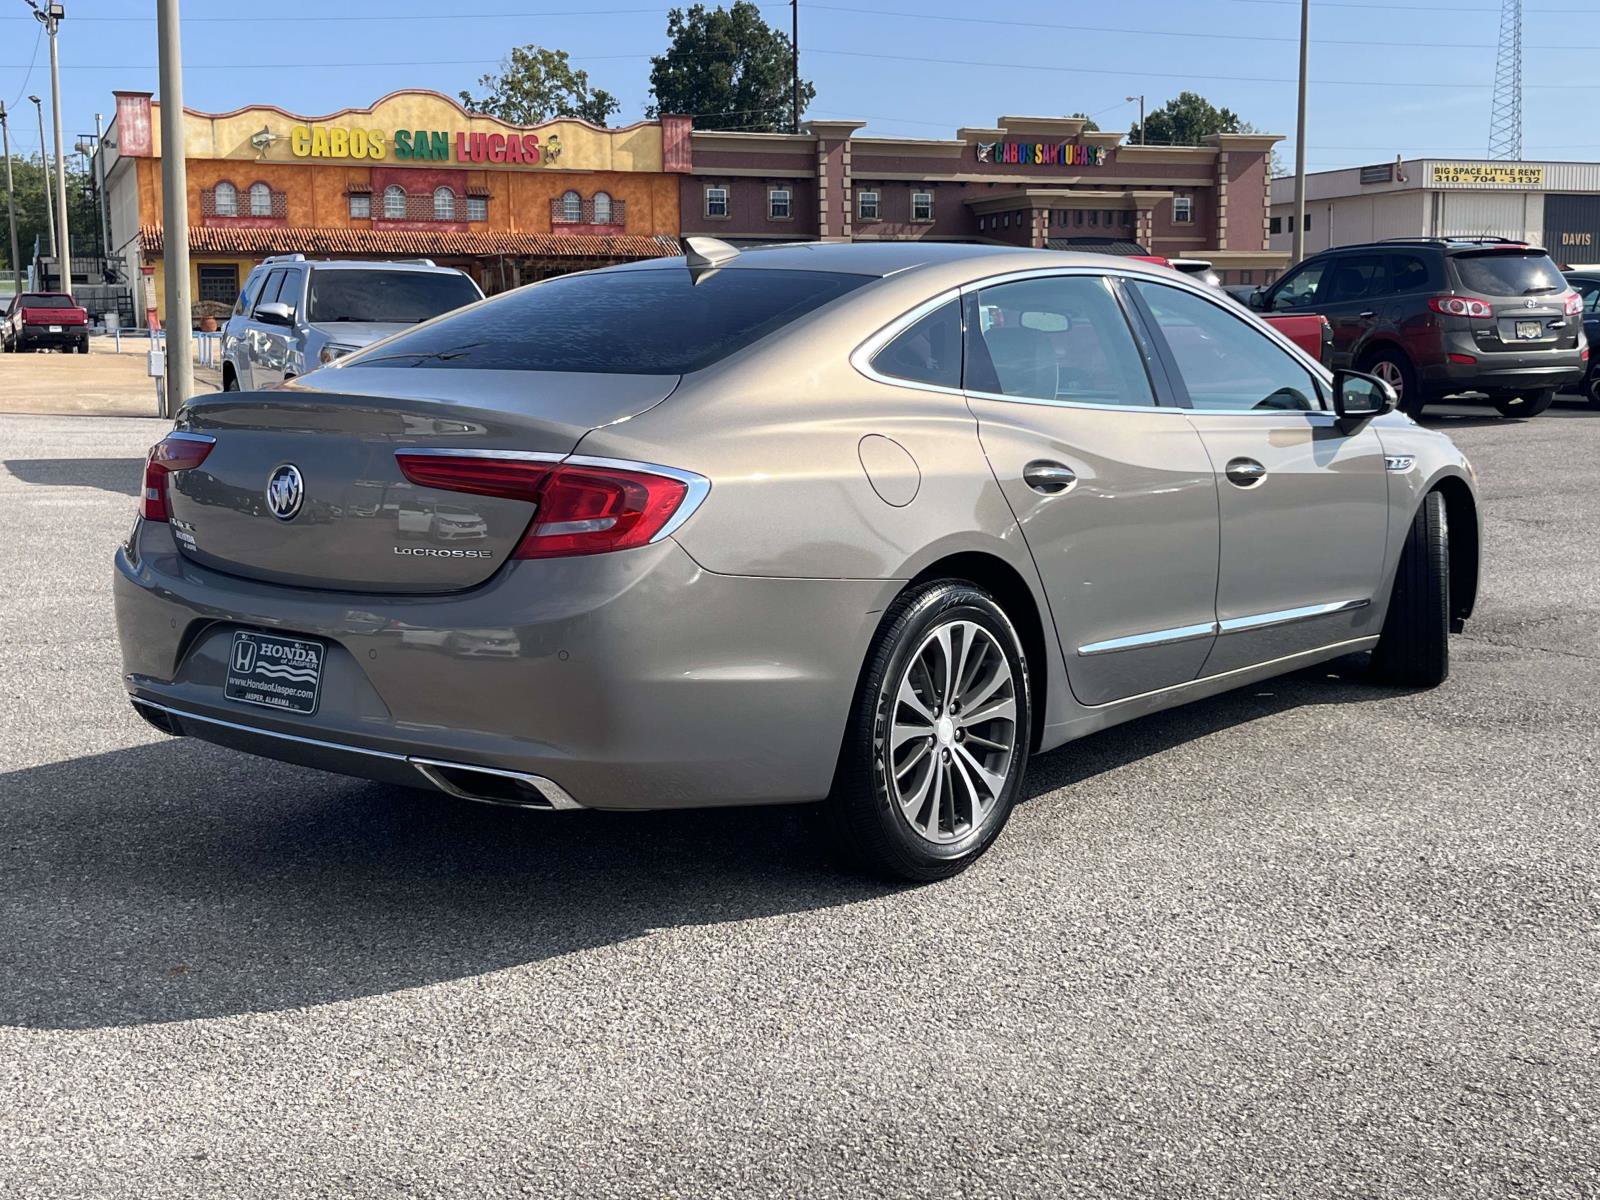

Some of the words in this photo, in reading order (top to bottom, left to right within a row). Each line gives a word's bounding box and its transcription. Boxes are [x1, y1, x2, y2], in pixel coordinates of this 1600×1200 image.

[290, 125, 386, 160] CABOS
[394, 129, 449, 161] SAN
[456, 132, 541, 164] LUCAS
[995, 143, 1034, 164] CABOS
[1035, 143, 1058, 164] SAN
[1059, 144, 1096, 165] LUCAS
[1434, 167, 1450, 175] BIG
[1453, 167, 1482, 175] SPACE
[1484, 168, 1515, 176] LITTLE
[1562, 233, 1591, 246] DAVIS
[260, 643, 318, 663] HONDA
[288, 661, 318, 669] JASPER
[229, 677, 314, 699] www.HondaofJasper.com
[265, 696, 289, 707] ALABAMA
